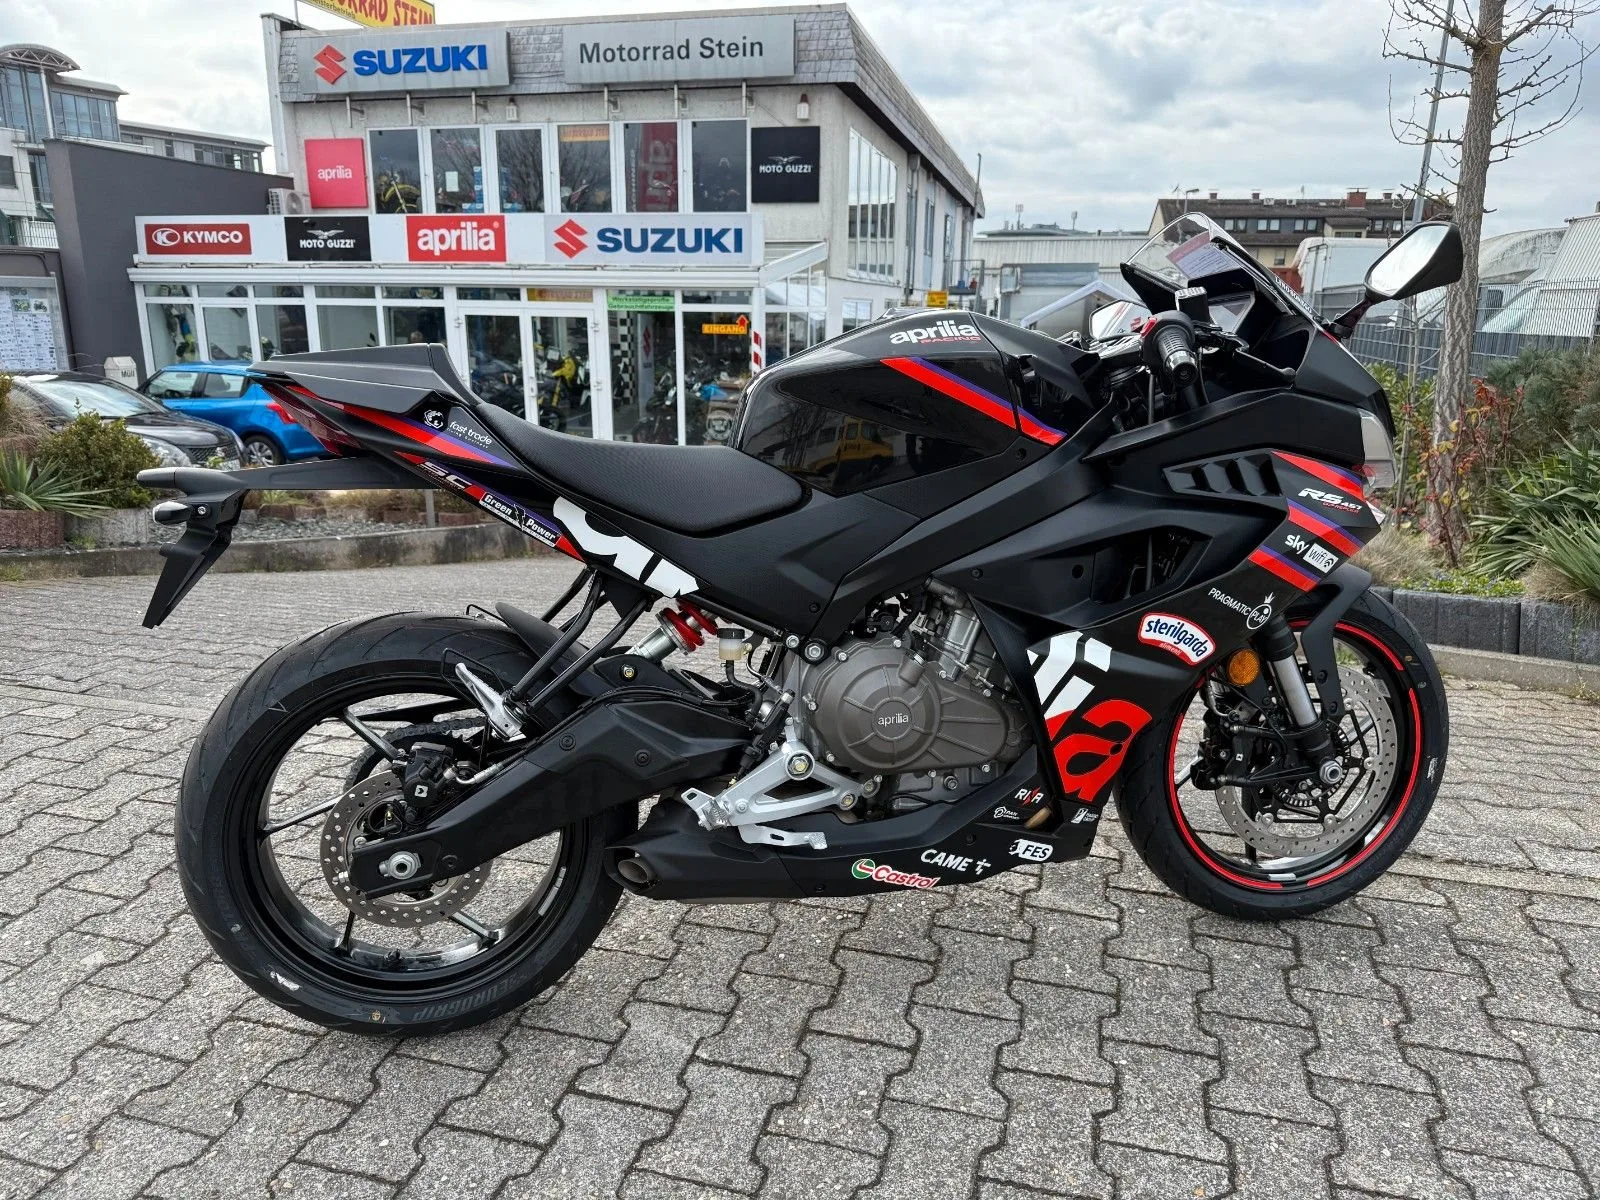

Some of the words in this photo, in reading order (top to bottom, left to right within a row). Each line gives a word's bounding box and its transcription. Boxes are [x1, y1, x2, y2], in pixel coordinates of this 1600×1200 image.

[353, 44, 488, 76] SUZUKI
[579, 38, 690, 64] Motorrad
[699, 36, 763, 59] Stein
[317, 164, 352, 181] aprilia
[759, 164, 783, 173] MOTO
[785, 164, 811, 173] GUZZI
[183, 230, 243, 244] KYMCO
[299, 239, 324, 248] MOTO
[327, 239, 355, 248] GUZZI
[417, 221, 496, 256] aprilia
[597, 228, 743, 254] SUZUKI
[889, 320, 979, 344] aprilia
[450, 421, 468, 434] fast
[467, 429, 492, 445] trade
[1298, 488, 1344, 505] RS
[484, 494, 513, 515] Green
[526, 518, 556, 540] Power
[1284, 534, 1310, 555] sky
[1208, 587, 1251, 615] PRAGMATIC
[1145, 618, 1208, 657] sterilgarda
[878, 712, 909, 727] aprilia
[920, 849, 973, 872] CAME
[1022, 844, 1050, 859] FES
[872, 864, 940, 888] Castrol
